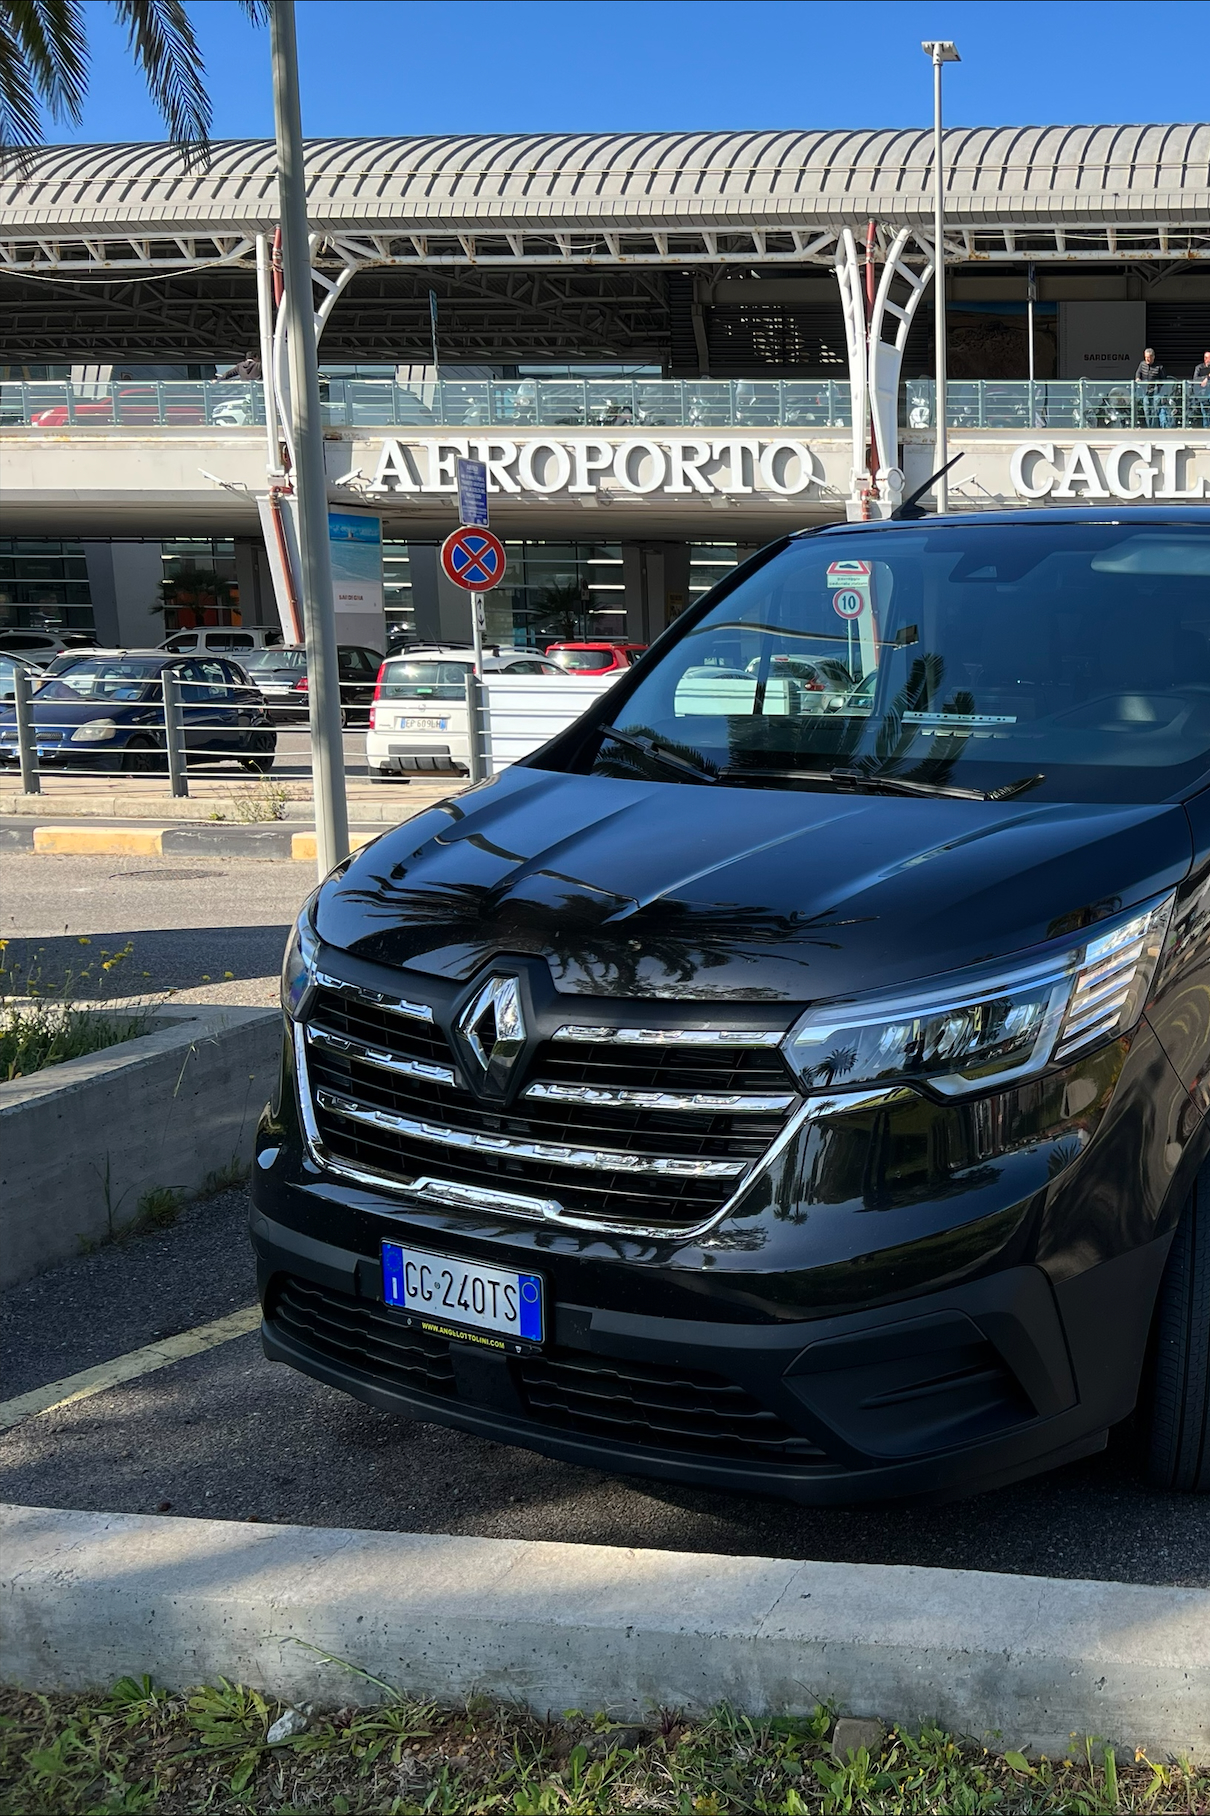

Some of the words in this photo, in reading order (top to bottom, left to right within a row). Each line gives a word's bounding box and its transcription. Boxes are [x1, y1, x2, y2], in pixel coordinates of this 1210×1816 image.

[1084, 353, 1130, 361] SARDEGNA
[368, 439, 814, 494] AEROPORTO
[842, 595, 857, 610] 10
[421, 1321, 506, 1350] WWW.ANGELOTTOLINI.COM
